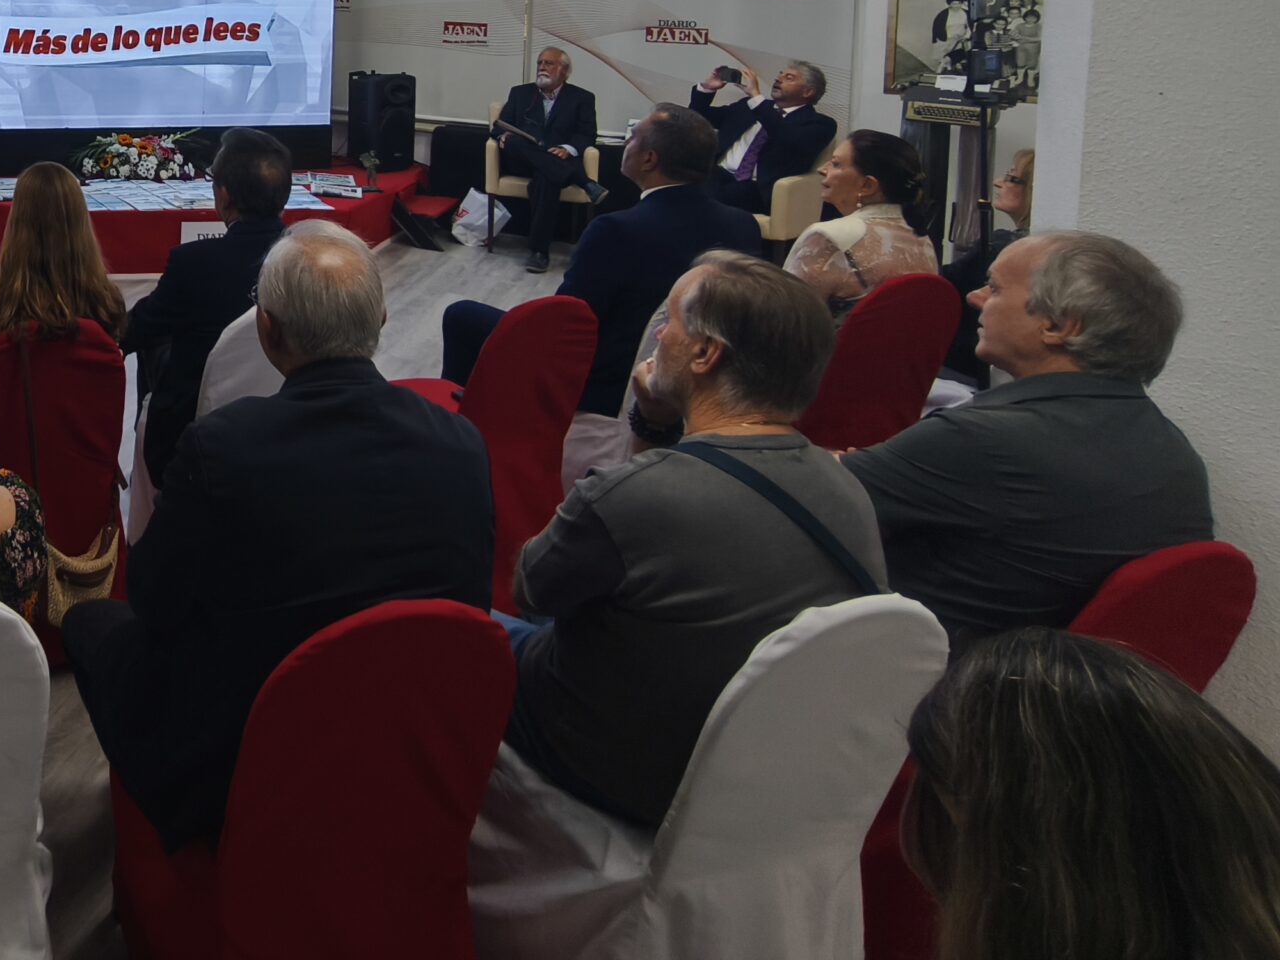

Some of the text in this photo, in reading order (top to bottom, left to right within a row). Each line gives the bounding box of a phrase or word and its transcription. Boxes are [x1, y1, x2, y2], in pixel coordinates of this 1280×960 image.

[658, 19, 697, 28] DIARIO
[3, 17, 262, 55] Más de lo que lees
[444, 25, 487, 37] JAEN
[646, 27, 708, 44] JAEN
